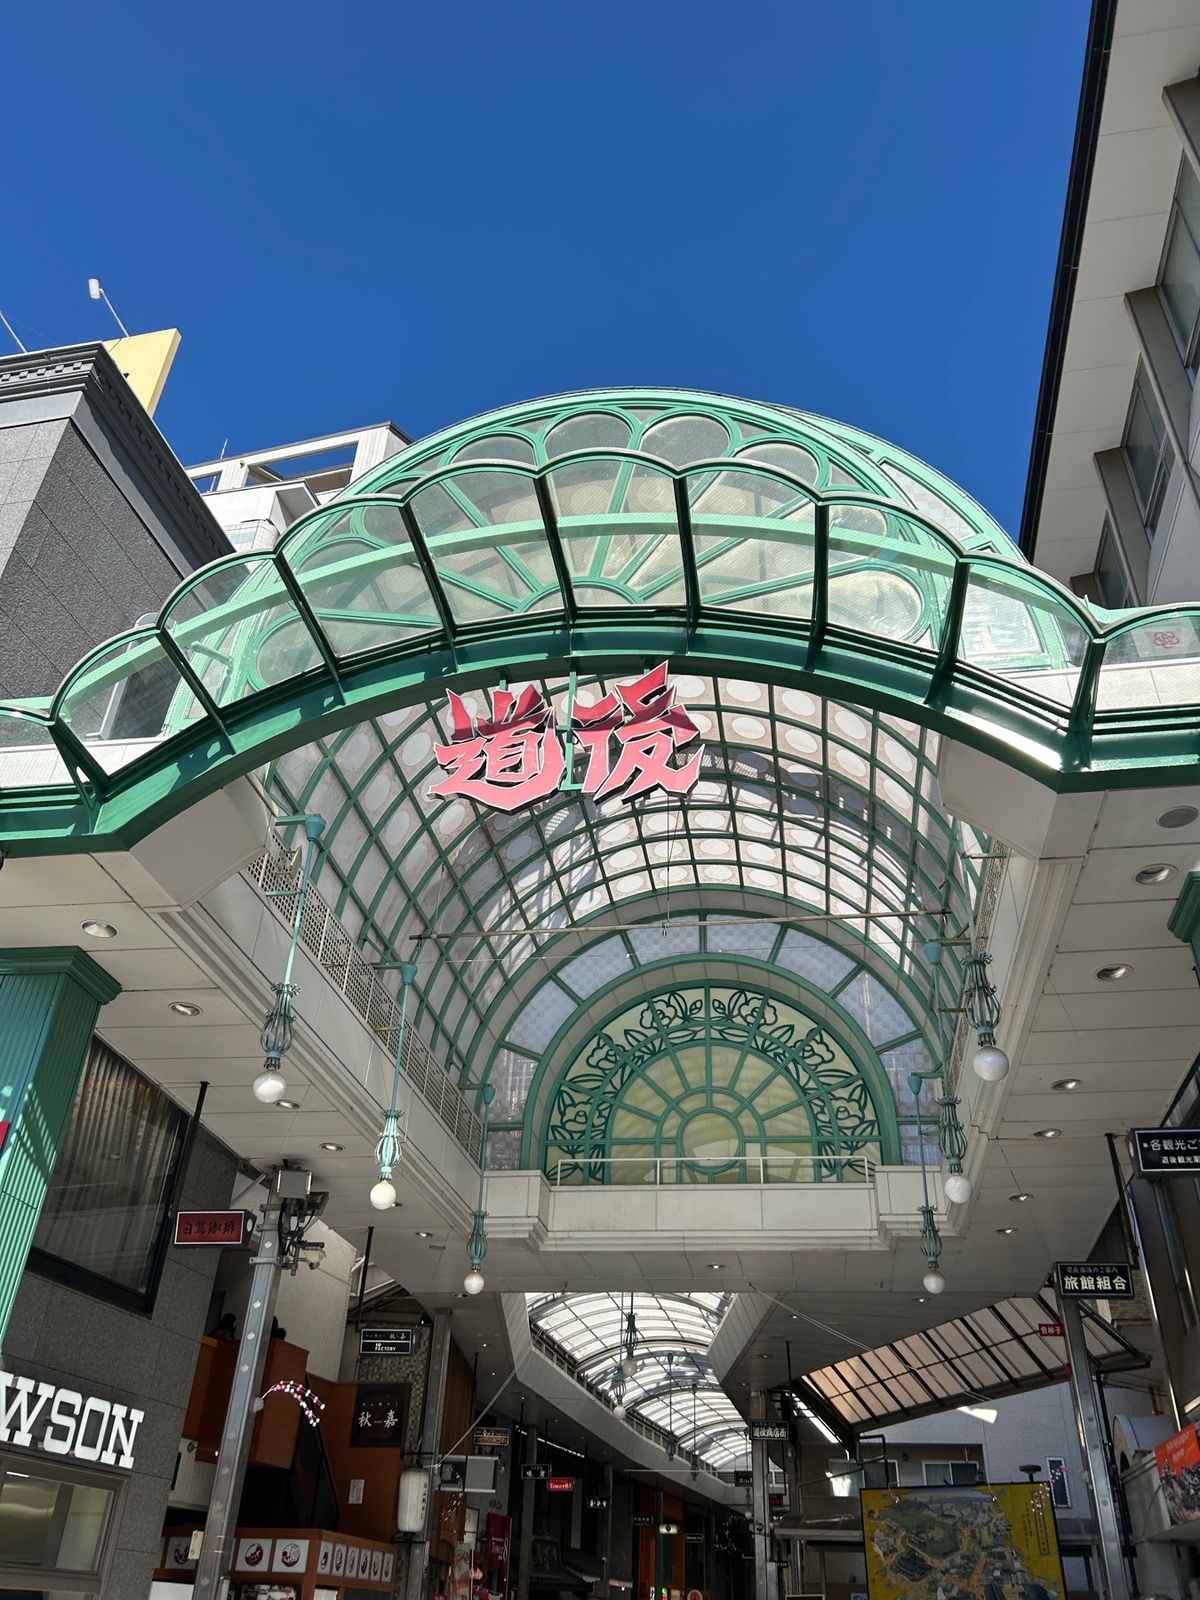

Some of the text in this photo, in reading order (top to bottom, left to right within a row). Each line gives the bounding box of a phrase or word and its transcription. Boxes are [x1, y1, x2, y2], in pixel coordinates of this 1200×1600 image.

[427, 660, 706, 813] 道後
[1150, 1138, 1200, 1151] 各観光ご
[1063, 1275, 1127, 1291] 旅館組合
[0, 1370, 144, 1470] WSON
